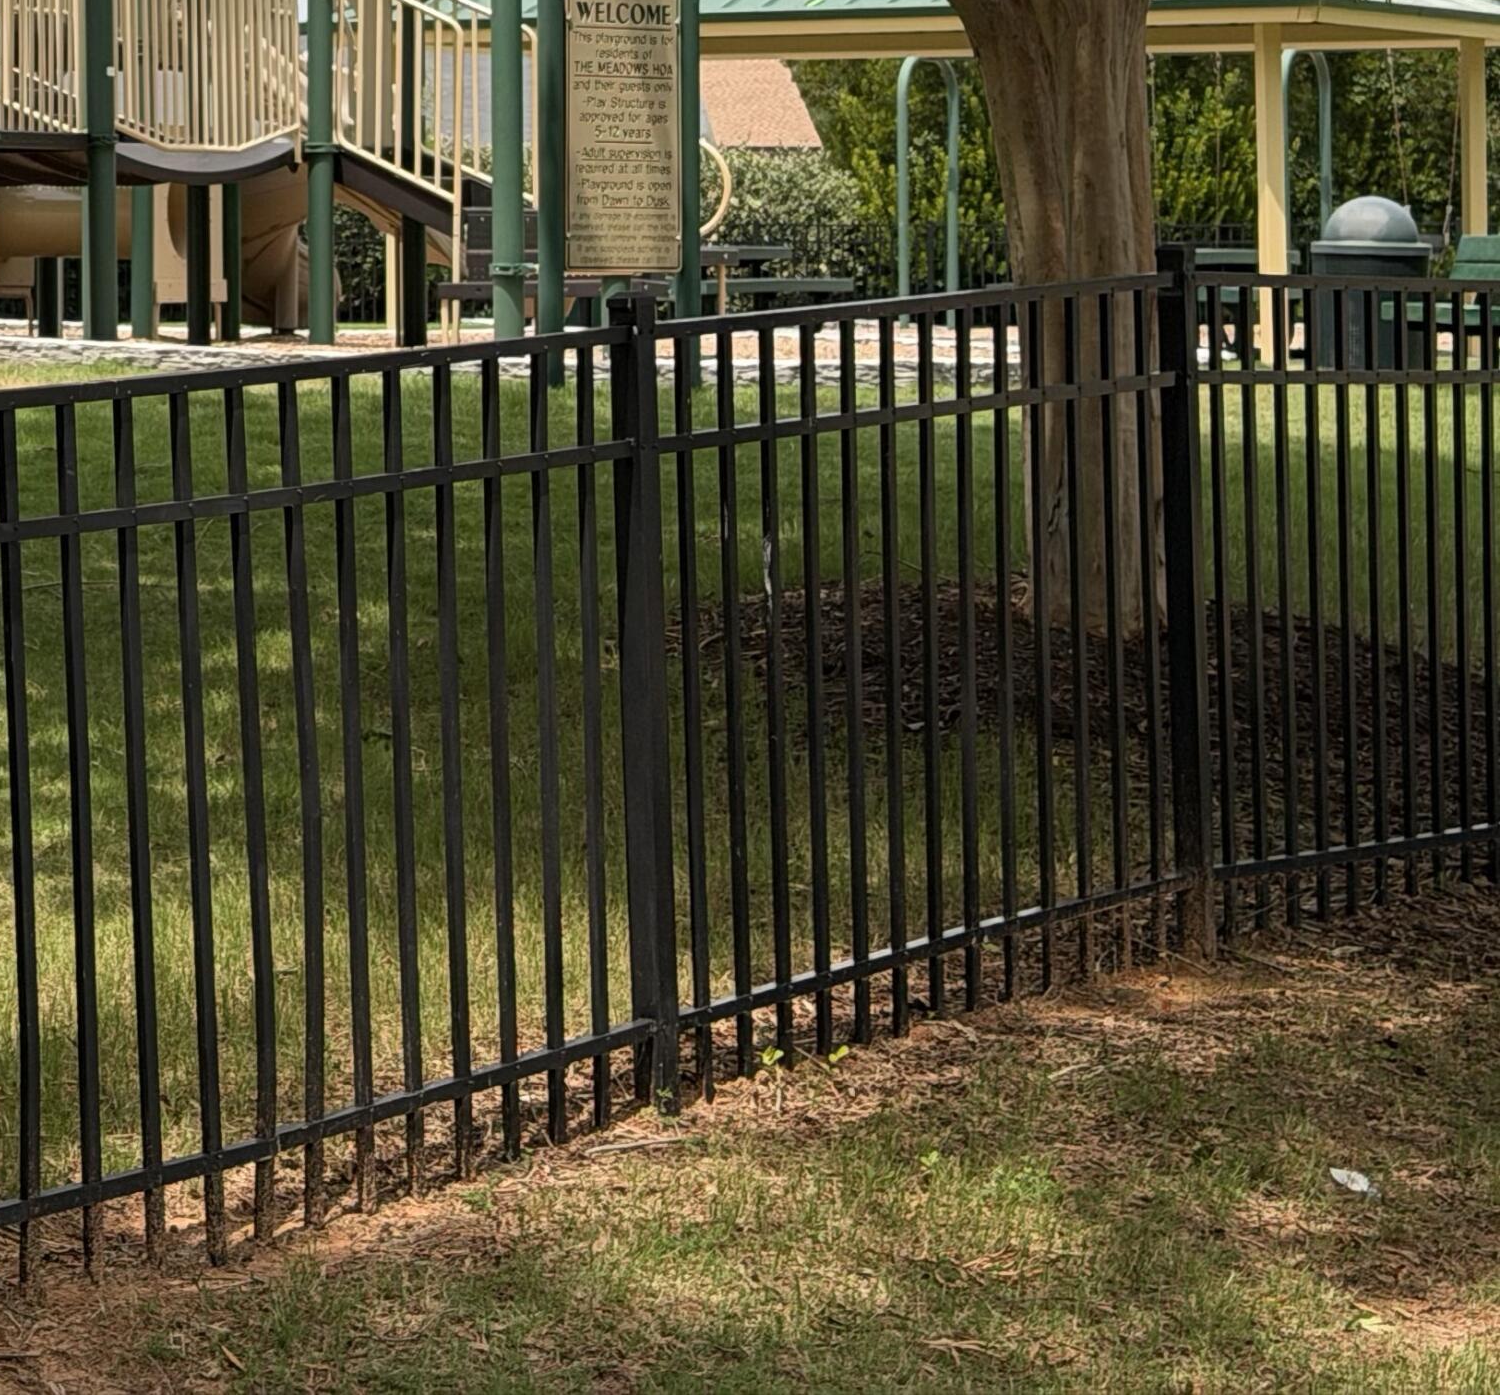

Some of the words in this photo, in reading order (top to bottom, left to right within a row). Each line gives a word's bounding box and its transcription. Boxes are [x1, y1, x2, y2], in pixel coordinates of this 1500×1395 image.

[576, 1, 671, 25] WELCOME
[572, 30, 592, 44] This
[595, 32, 647, 47] playground
[649, 35, 658, 45] is
[661, 34, 674, 46] for
[595, 48, 639, 59] residents
[642, 49, 652, 60] of
[574, 60, 593, 73] THE
[598, 61, 649, 75] MEADOWS
[653, 63, 673, 75] HOA
[573, 79, 590, 91] and
[595, 79, 615, 91] their
[619, 80, 650, 94] guests
[610, 96, 655, 109] Structure
[658, 100, 666, 109] is
[579, 112, 625, 125] approved
[628, 112, 642, 123] for
[645, 113, 669, 126] ages
[595, 125, 620, 137] 5-12
[622, 127, 651, 140] years
[664, 149, 672, 160] is
[617, 163, 628, 174] at
[646, 163, 671, 175] times
[636, 179, 645, 190] is
[648, 181, 672, 192] open
[577, 193, 598, 206] from
[602, 194, 629, 206] Dawn
[632, 194, 643, 205] to
[646, 195, 669, 206] Dusk
